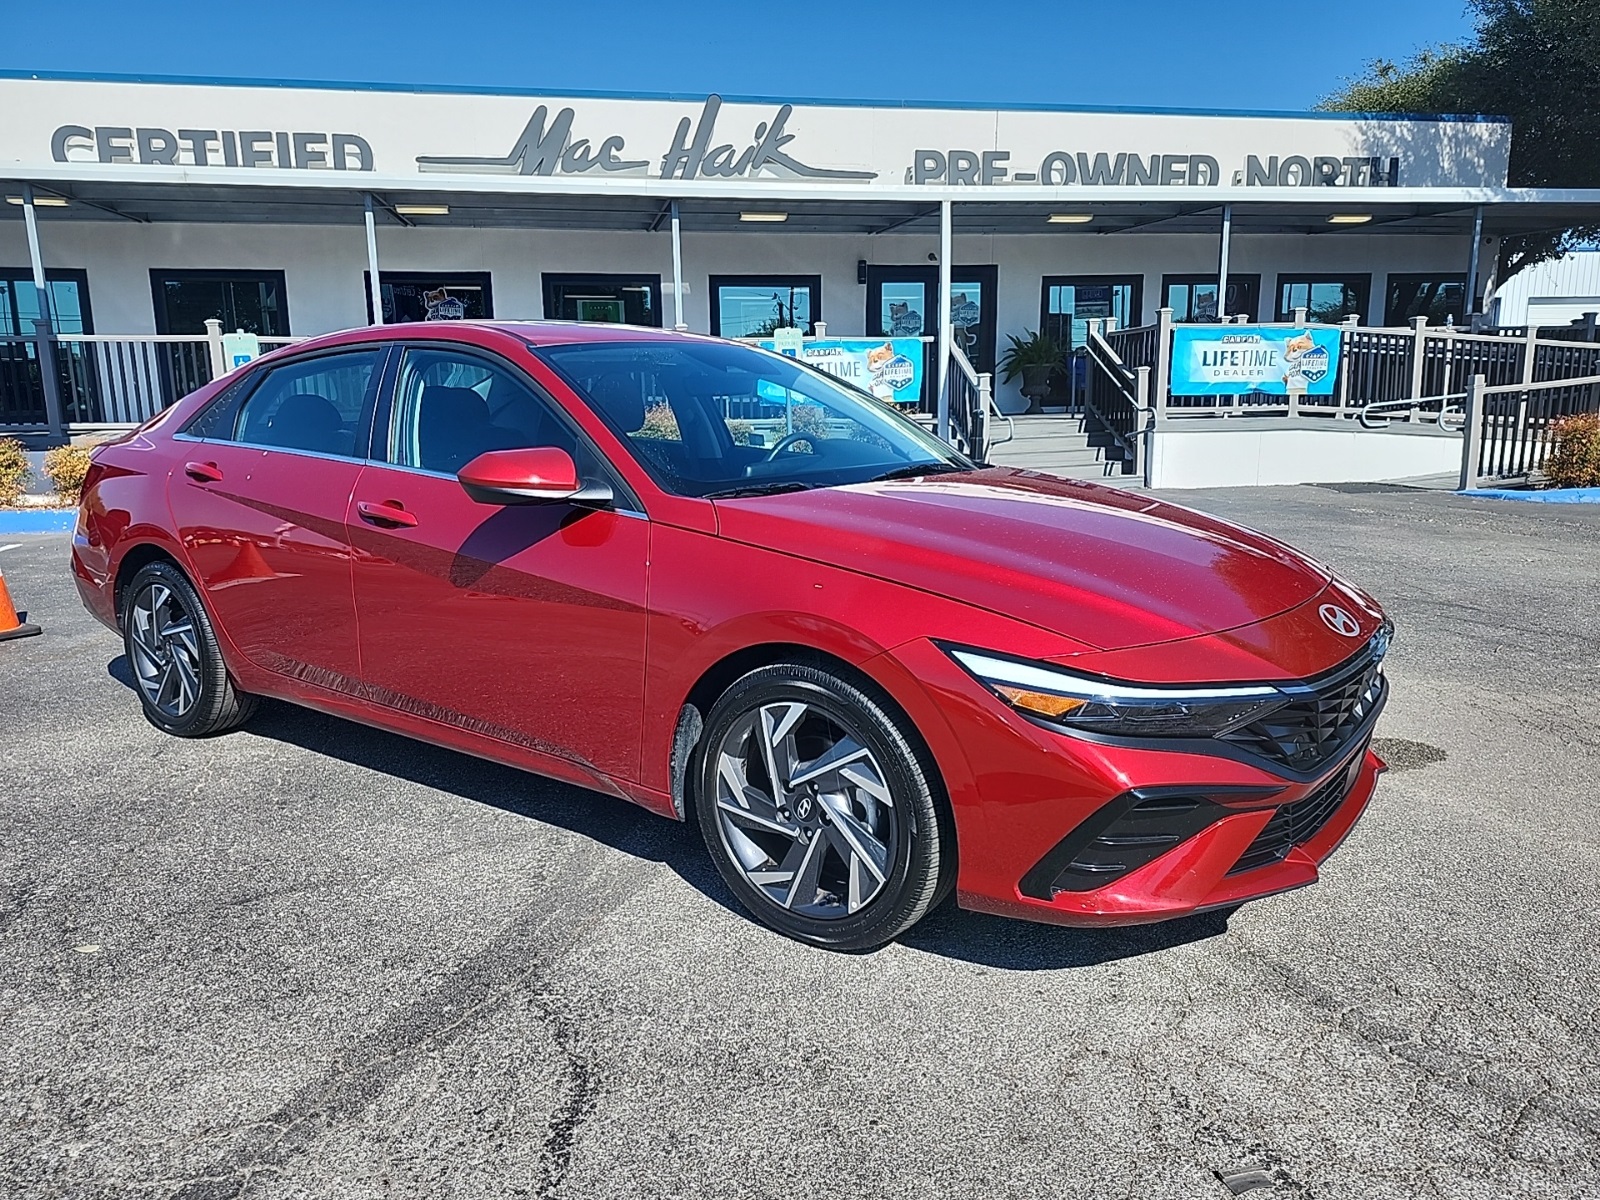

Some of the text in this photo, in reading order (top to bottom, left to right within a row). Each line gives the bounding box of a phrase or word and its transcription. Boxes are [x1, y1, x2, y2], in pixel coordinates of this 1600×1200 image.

[50, 124, 375, 171] CERTIFIED
[416, 94, 878, 180] Mac Haik
[914, 149, 1399, 187] PRE-OWNED NORTH
[806, 349, 842, 357] CARFAX
[1222, 335, 1260, 344] CARFAX
[1202, 350, 1278, 367] LIFETIME
